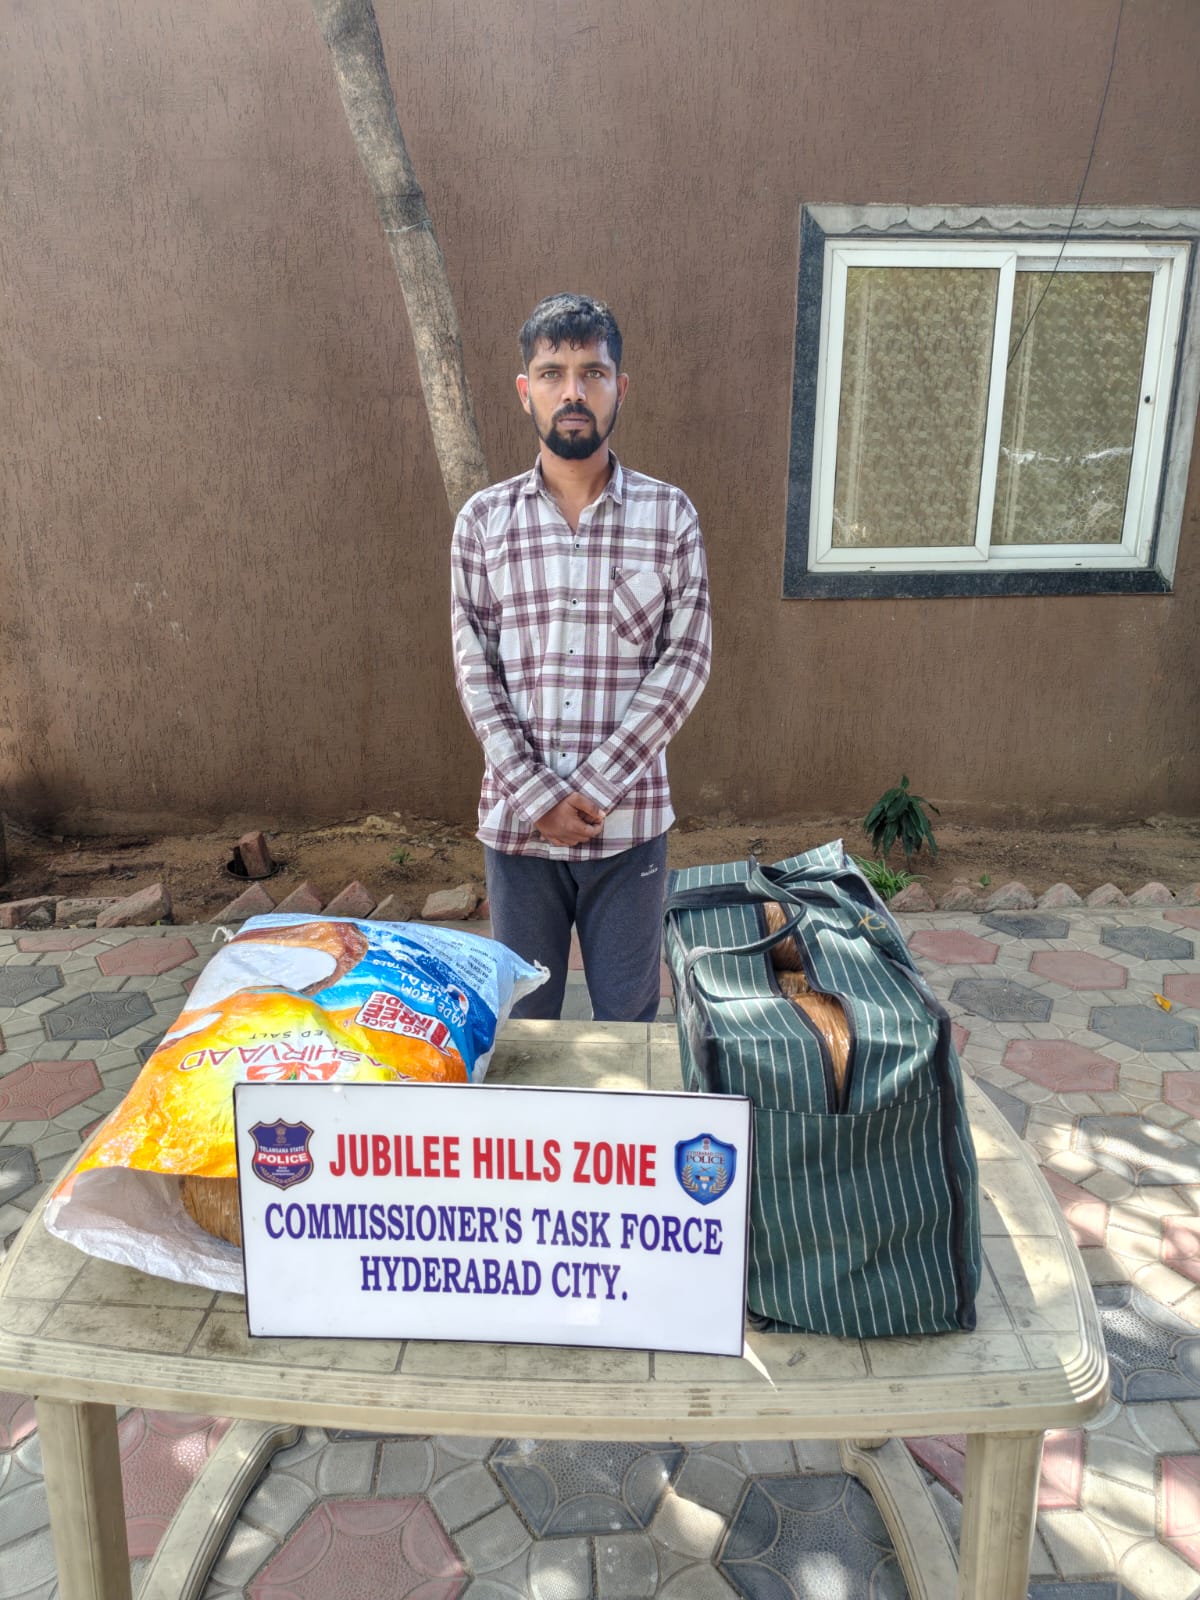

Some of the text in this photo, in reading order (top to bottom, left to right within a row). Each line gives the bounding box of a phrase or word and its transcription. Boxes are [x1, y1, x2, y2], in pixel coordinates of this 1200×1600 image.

[397, 970, 460, 1011] ATURAL
[401, 983, 435, 1004] FROM
[361, 1015, 397, 1030] PACK
[248, 1030, 292, 1040] SALT
[257, 1152, 309, 1164] POLICE
[329, 1133, 657, 1187] JUBILEE HILLS ZONE
[686, 1155, 726, 1165] POLICE
[264, 1203, 724, 1256] COMMISSIONER'S TASK FORCE
[360, 1255, 629, 1301] HYDERABAD CITY.
